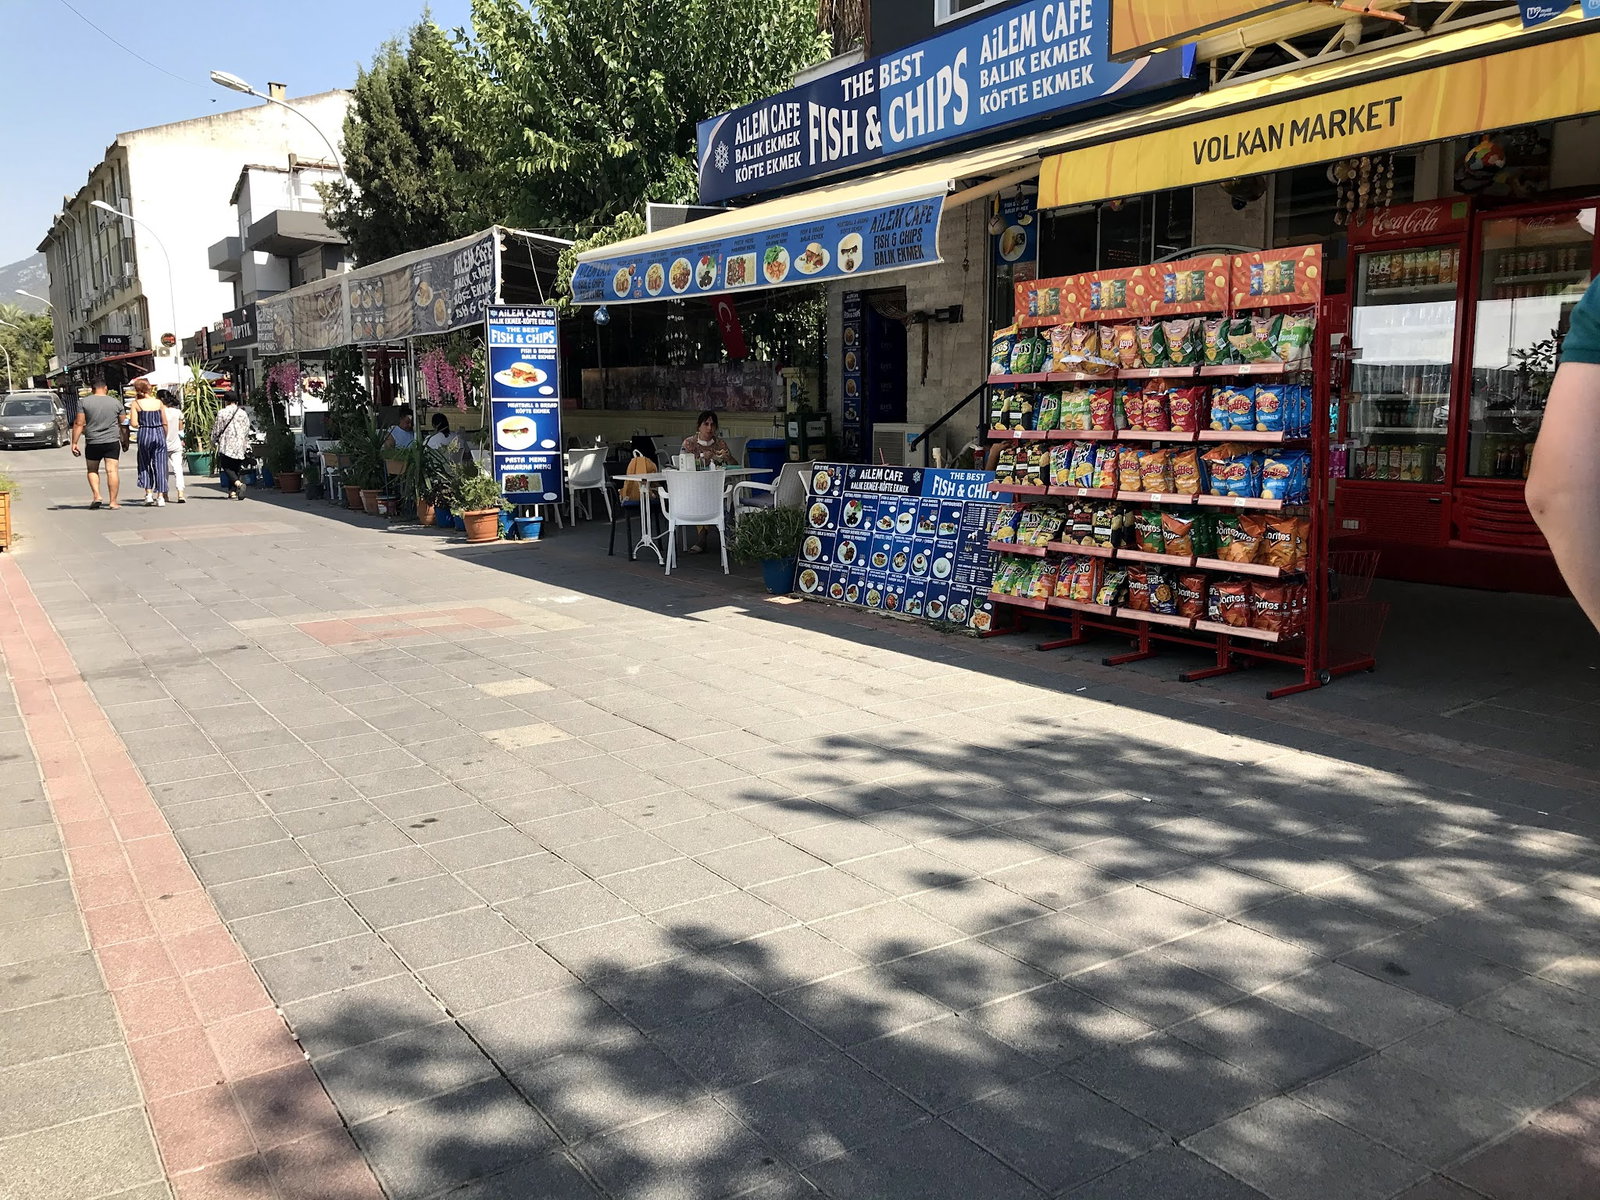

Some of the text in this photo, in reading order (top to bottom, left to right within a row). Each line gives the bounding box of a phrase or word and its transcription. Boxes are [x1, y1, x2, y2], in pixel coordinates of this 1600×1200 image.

[1041, 0, 1093, 44] CAFE
[980, 35, 1092, 89] BALIK EKMEK
[841, 50, 924, 102] THE BEST
[980, 64, 1094, 115] KÖFTE EKMEK
[808, 46, 969, 166] FISH & CHIPS
[771, 102, 800, 134] CAFE
[1192, 96, 1402, 165] VOLKAN MARKET
[735, 130, 800, 164] BALIK EKMEK
[735, 151, 802, 184] KÖFTE EKMEK
[904, 203, 934, 228] CAFE
[873, 232, 890, 250] FISH
[899, 228, 923, 246] CHIPS
[874, 251, 894, 267] BALIK
[526, 309, 546, 318] CAFE
[490, 328, 555, 344] FISH & CHIPS
[885, 469, 904, 482] CAFE
[932, 475, 956, 496] FISH
[958, 484, 968, 497] &
[950, 472, 986, 482] THE BEST
[894, 484, 910, 494] EKMEK
[1266, 532, 1291, 541] oritos
[1220, 593, 1246, 604] oritos
[1255, 601, 1279, 610] oritos
